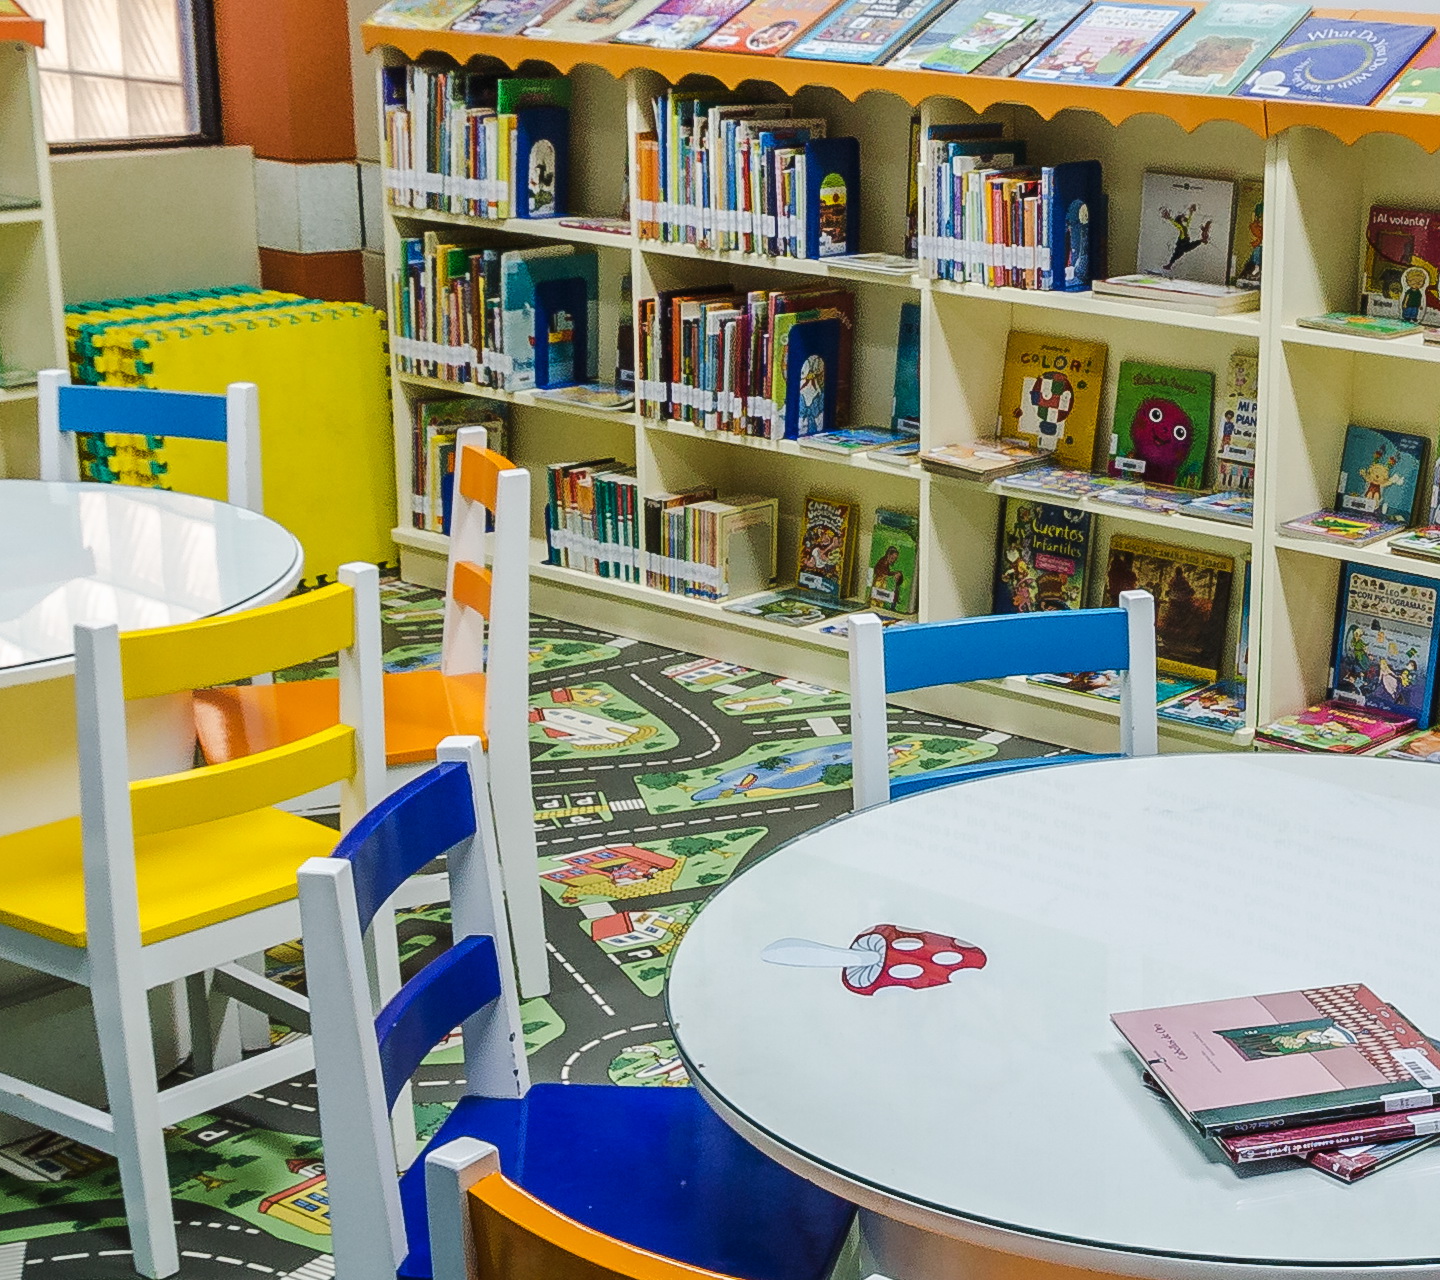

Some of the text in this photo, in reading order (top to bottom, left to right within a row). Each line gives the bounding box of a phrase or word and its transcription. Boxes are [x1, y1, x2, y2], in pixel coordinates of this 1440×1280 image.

[1308, 27, 1357, 43] What
[1390, 215, 1430, 229] volante!
[1032, 519, 1084, 543] Cuentos
